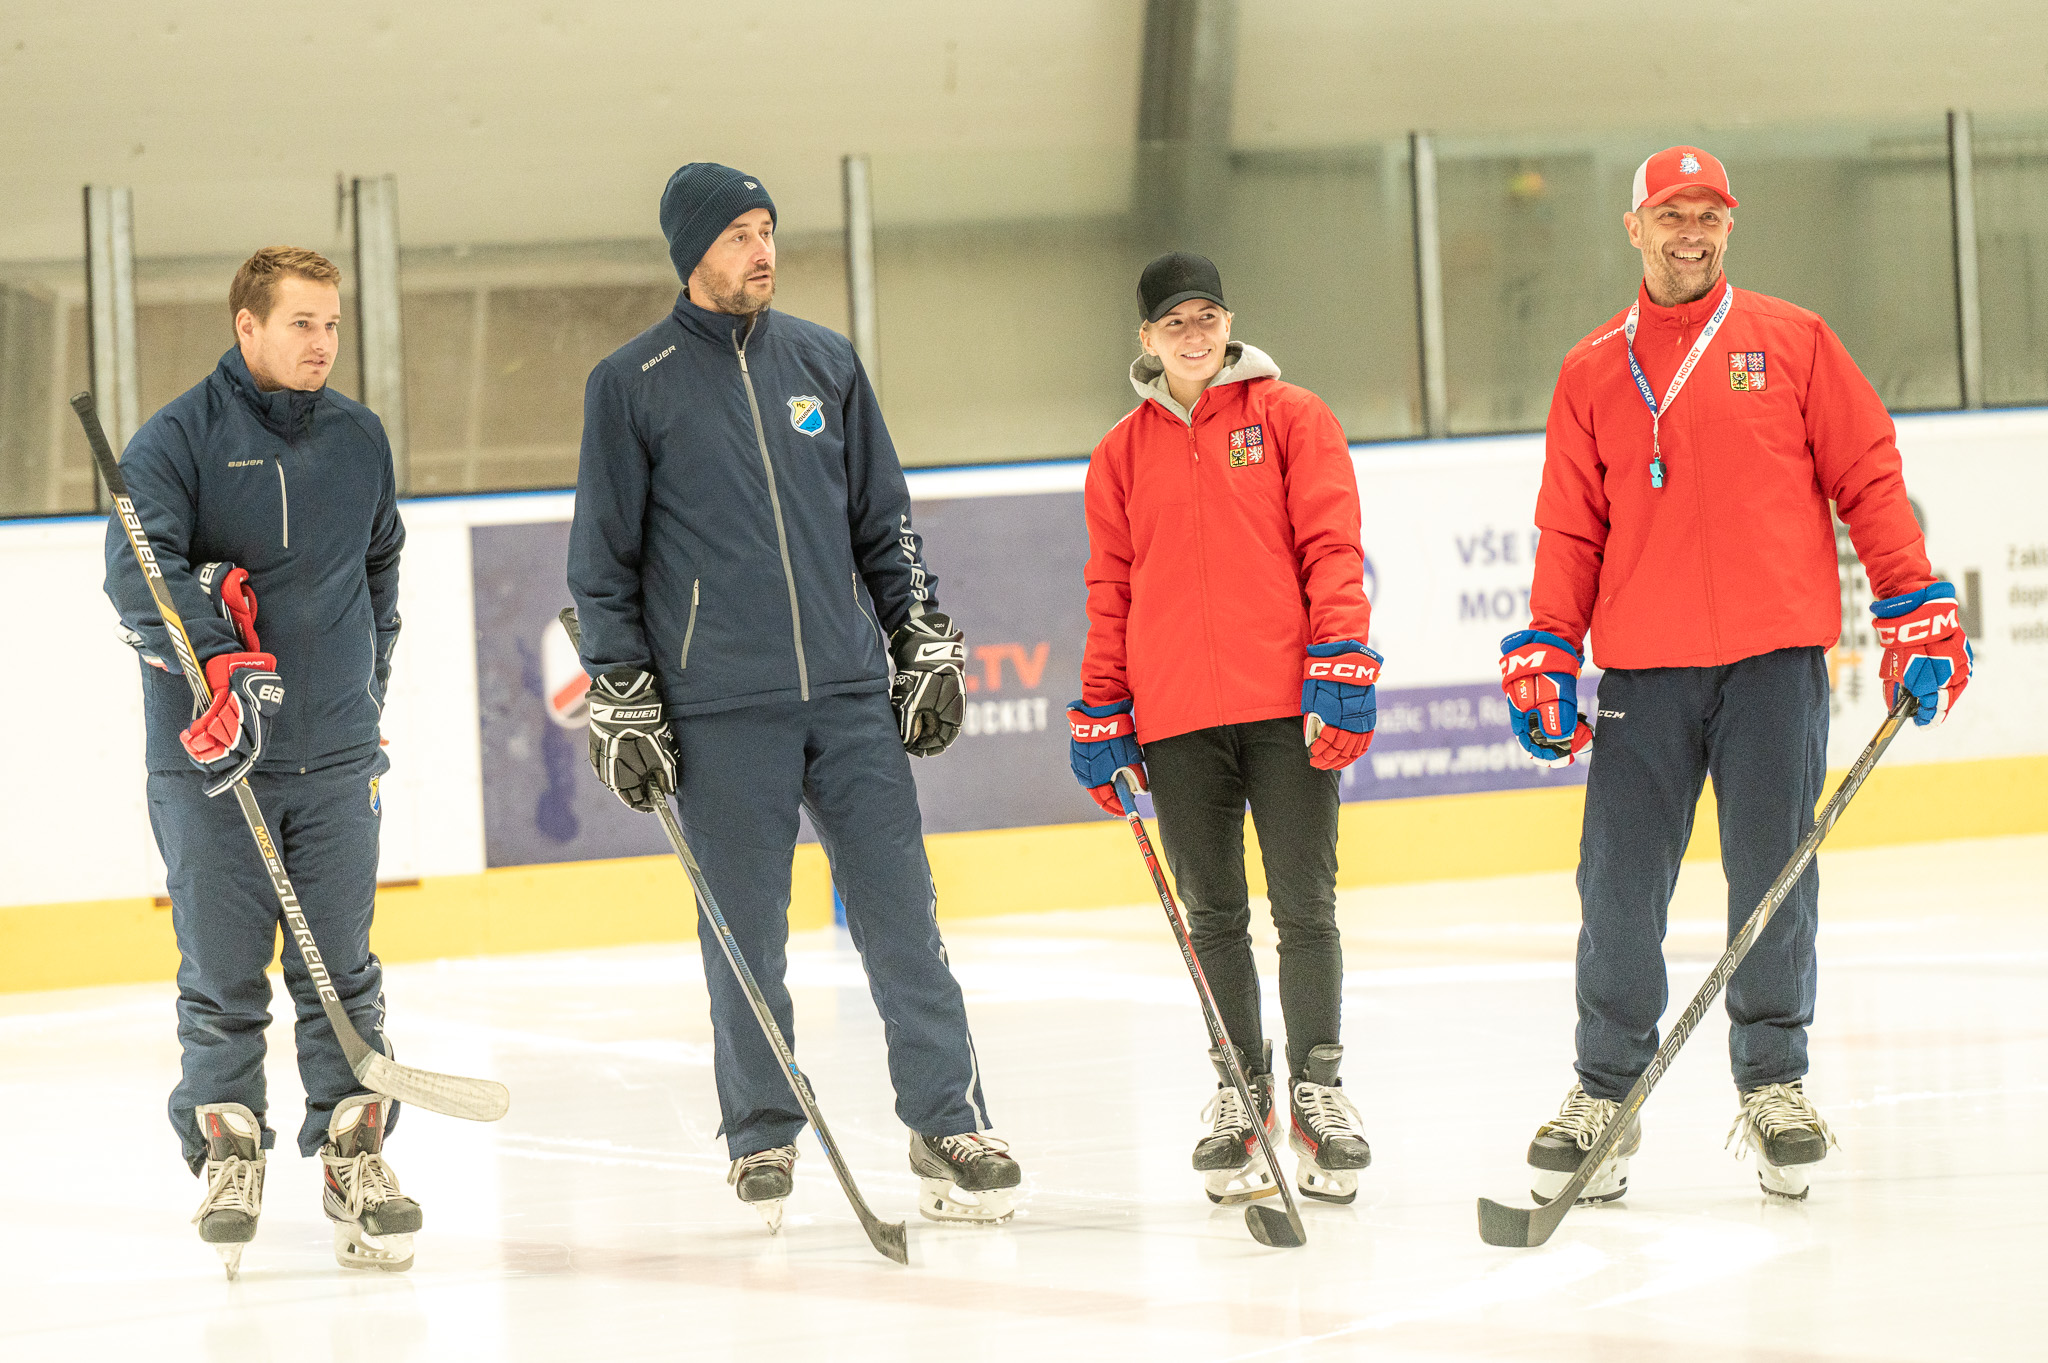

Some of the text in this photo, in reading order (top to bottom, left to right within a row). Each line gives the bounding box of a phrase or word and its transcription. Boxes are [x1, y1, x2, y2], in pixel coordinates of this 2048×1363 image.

[1713, 299, 1730, 324] CZECH
[641, 345, 676, 372] BAUER
[1670, 380, 1682, 394] ICE
[1677, 347, 1701, 379] HOCKEY
[1631, 362, 1641, 377] ICE
[1636, 376, 1657, 407] HOCKEY
[228, 459, 264, 468] BAUER
[117, 497, 162, 579] BAUER
[1876, 608, 1959, 645] CCM
[1309, 662, 1376, 680] CCM
[615, 709, 657, 719] BAUER
[964, 697, 1049, 735] OCKET
[1548, 705, 1557, 731] CCM
[1597, 709, 1626, 719] CCM
[1848, 745, 1872, 778] BAUER
[1844, 757, 1875, 804] BAUER
[1772, 848, 1811, 904] TOTALONE
[272, 876, 340, 1003] SUPREME
[1184, 951, 1199, 979] BAUER
[1643, 946, 1737, 1095] BAUER
[769, 1022, 793, 1064] NEXUS
[1630, 1094, 1645, 1114] NXG
